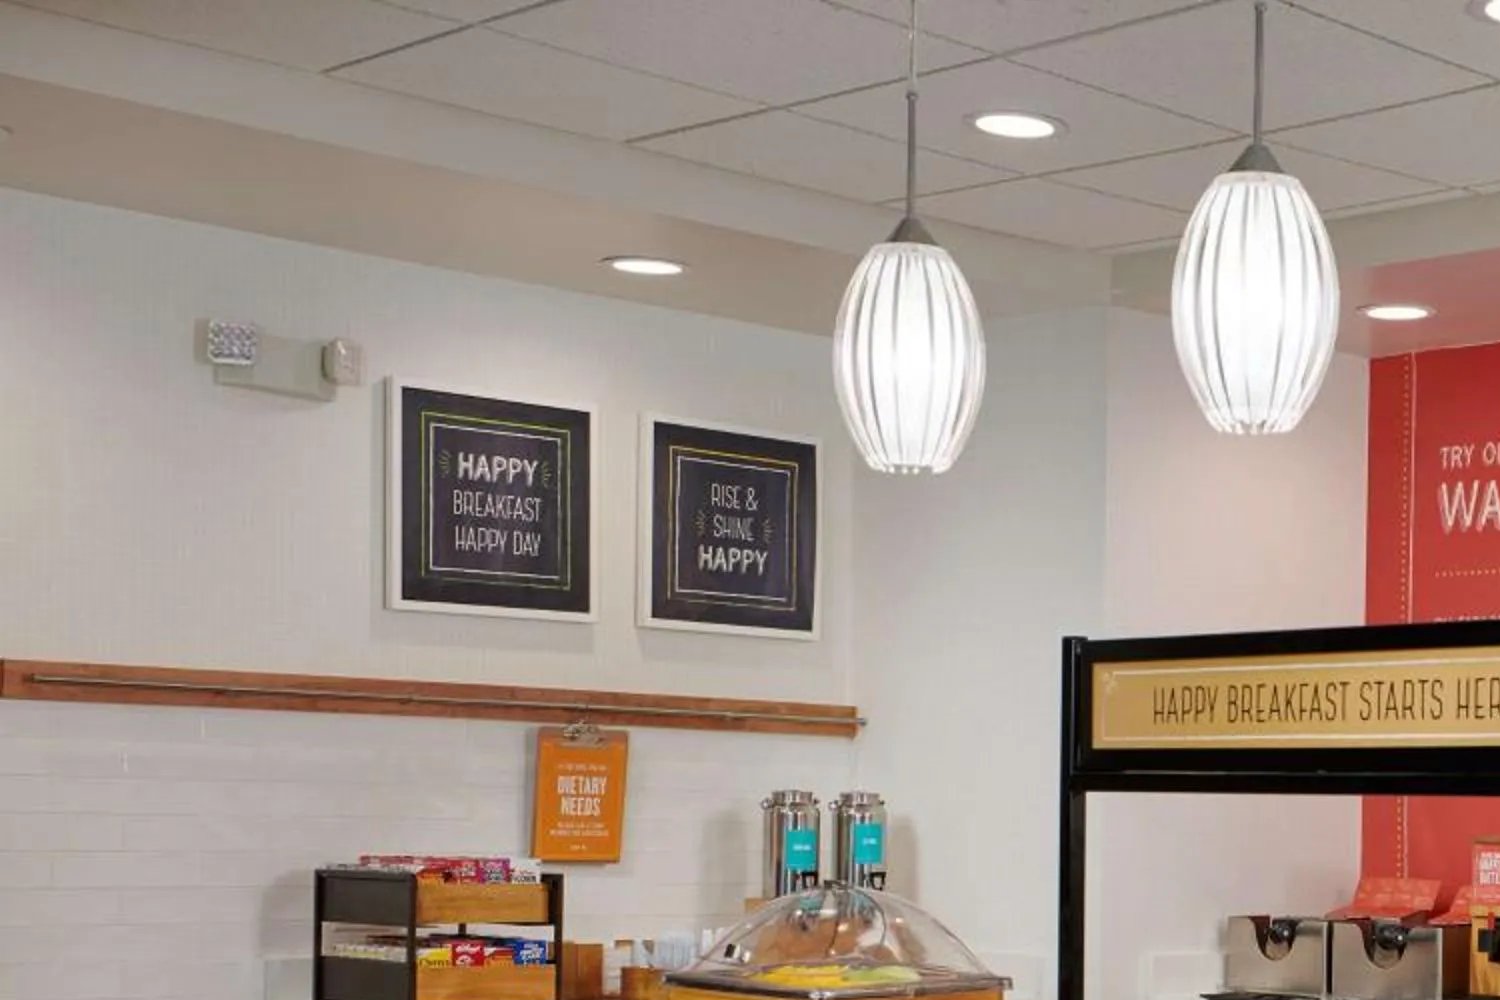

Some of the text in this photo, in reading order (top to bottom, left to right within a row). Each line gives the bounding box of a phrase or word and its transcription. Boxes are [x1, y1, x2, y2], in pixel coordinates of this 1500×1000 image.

[457, 451, 539, 487] HAPPY
[1440, 443, 1475, 470] TRY
[453, 489, 541, 522] BREAKFAST
[711, 483, 759, 511] RISE &
[455, 525, 541, 557] HAPPY DAY
[713, 513, 755, 542] SHINE
[698, 544, 768, 576] HAPPY
[1153, 685, 1218, 725] HAPPY
[1226, 681, 1350, 724] BREAKFAST
[1359, 679, 1444, 721] STARTS
[557, 775, 607, 796] DIETARY
[561, 796, 601, 816] NEEDS
